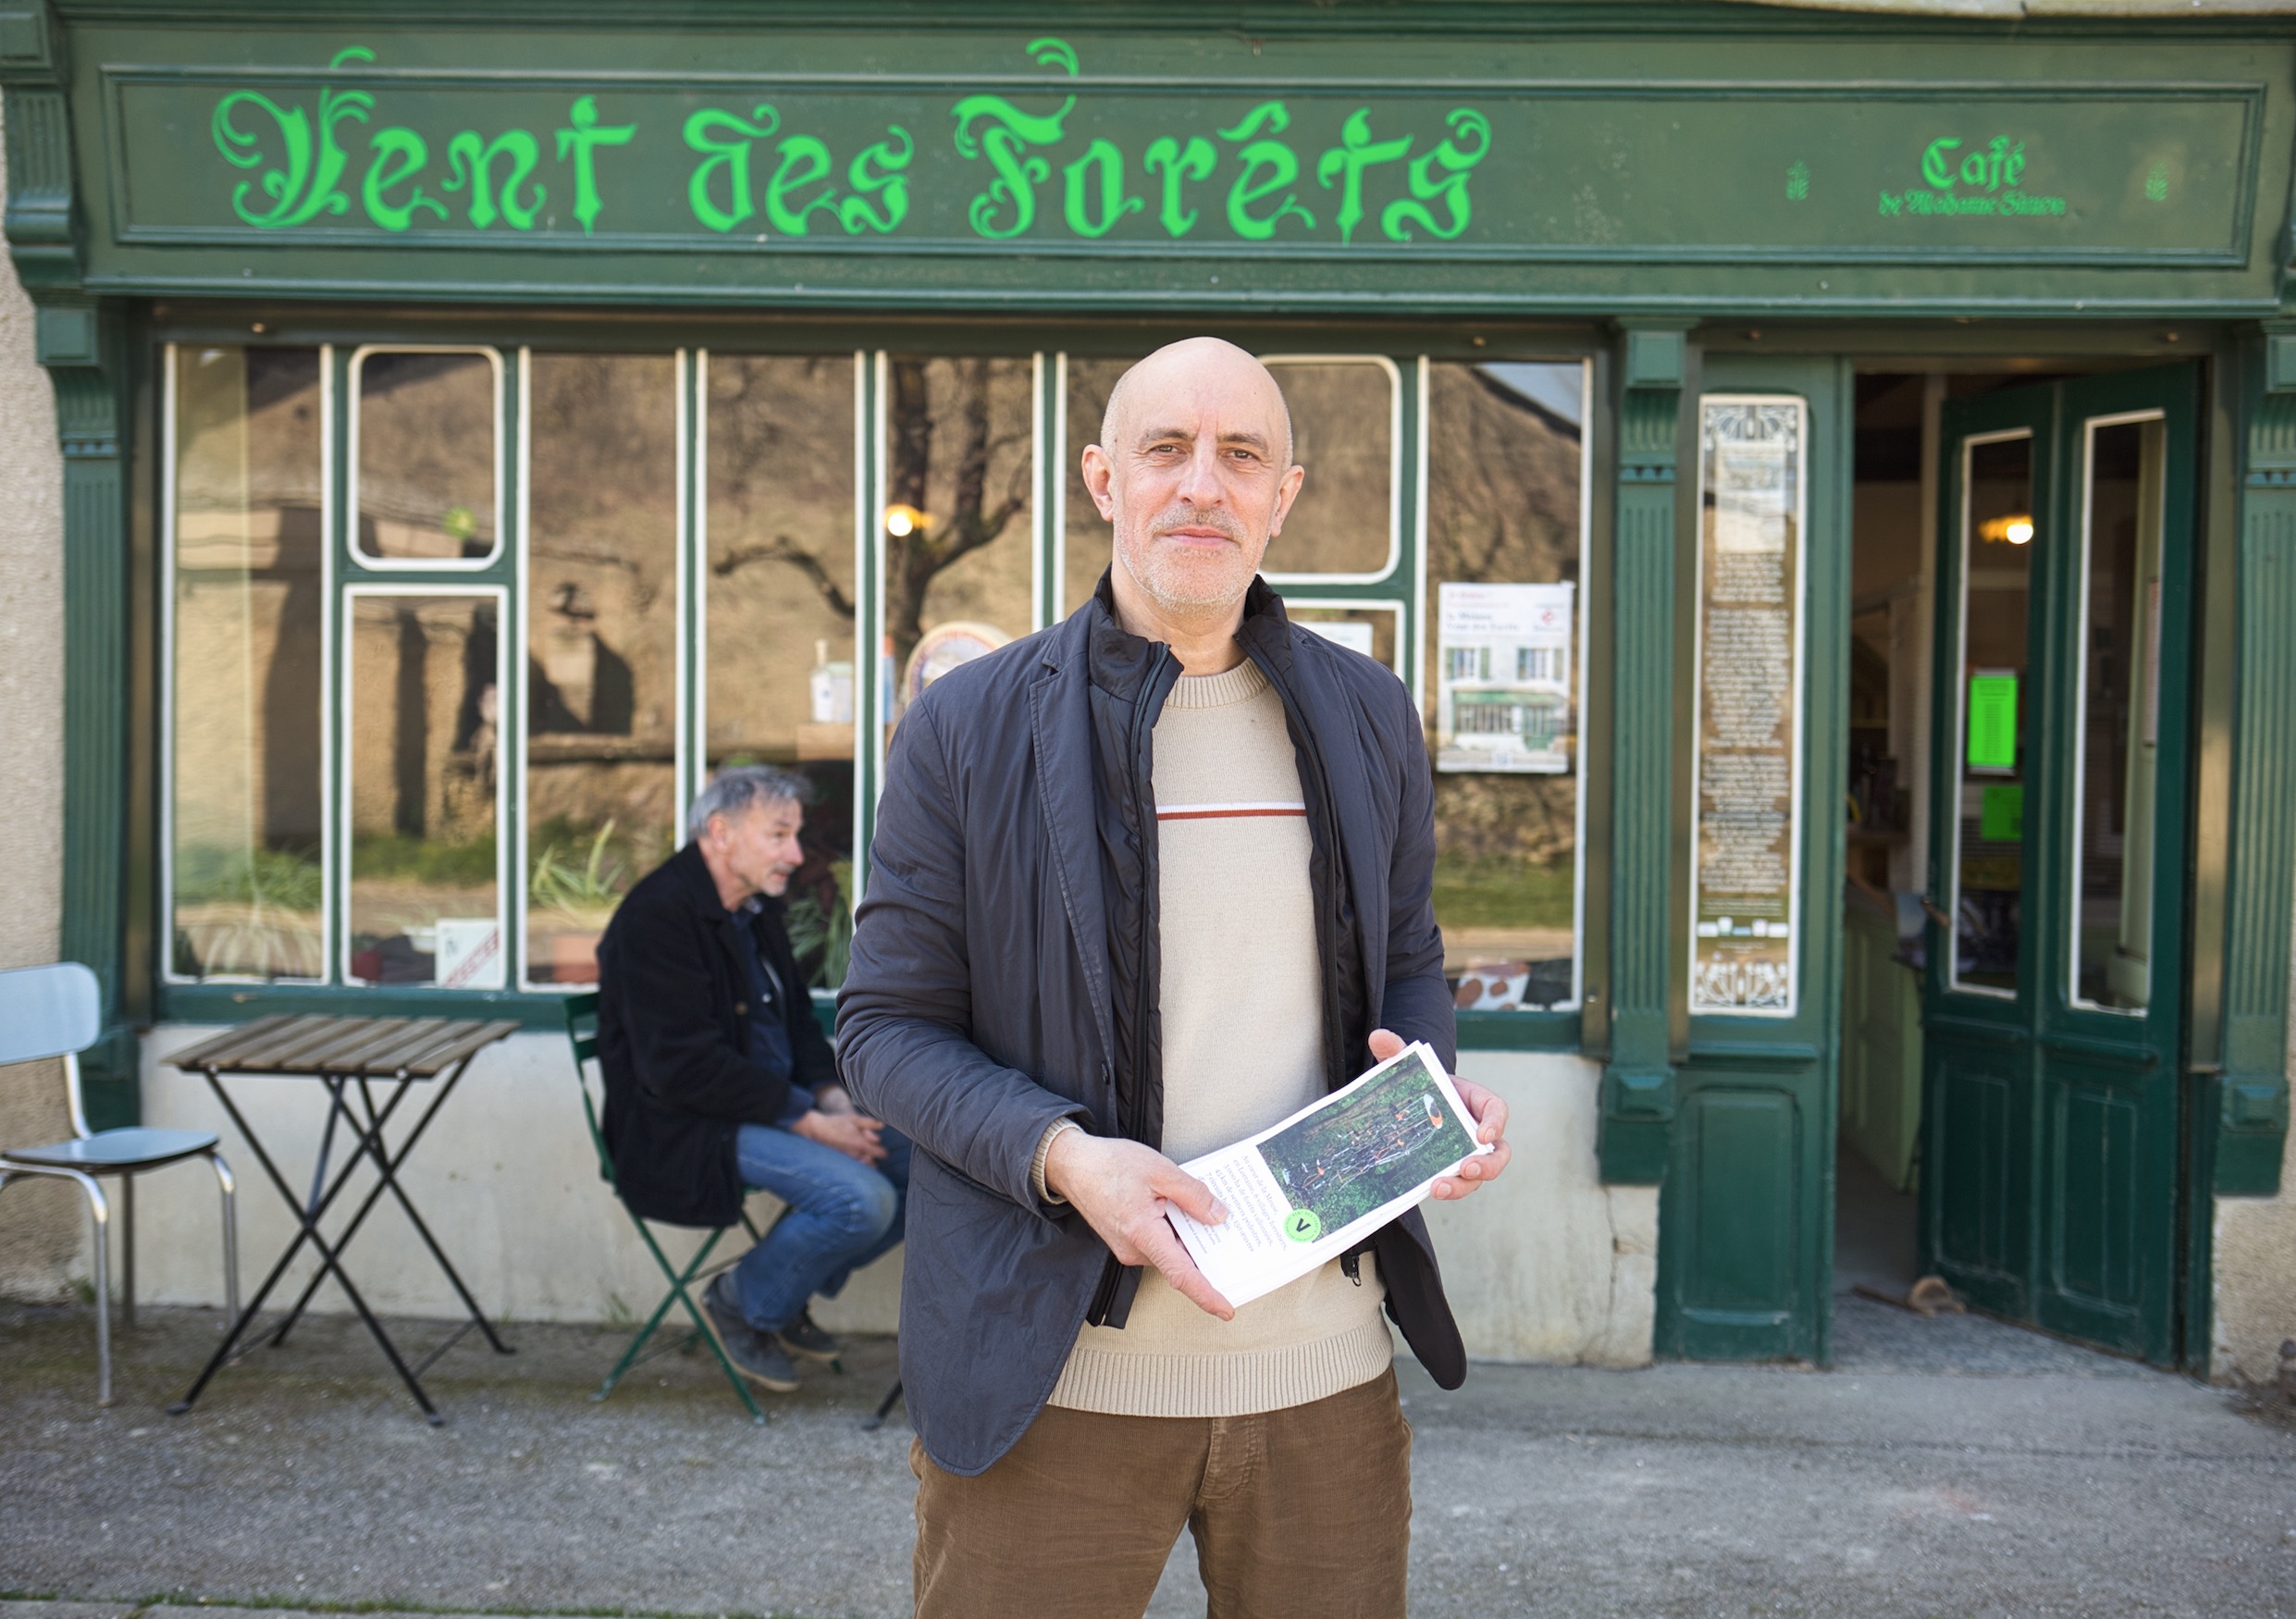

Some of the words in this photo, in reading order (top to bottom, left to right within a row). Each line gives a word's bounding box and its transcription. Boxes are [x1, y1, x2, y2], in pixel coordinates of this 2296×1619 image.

[212, 45, 638, 236] Vent
[682, 103, 913, 236] des
[950, 37, 1492, 245] Forêts
[1921, 135, 2027, 190] Café
[1208, 1177, 1224, 1198] circuits
[1238, 1167, 1255, 1194] Lorraine,
[1256, 1198, 1271, 1221] villages
[1296, 1217, 1311, 1232] V
